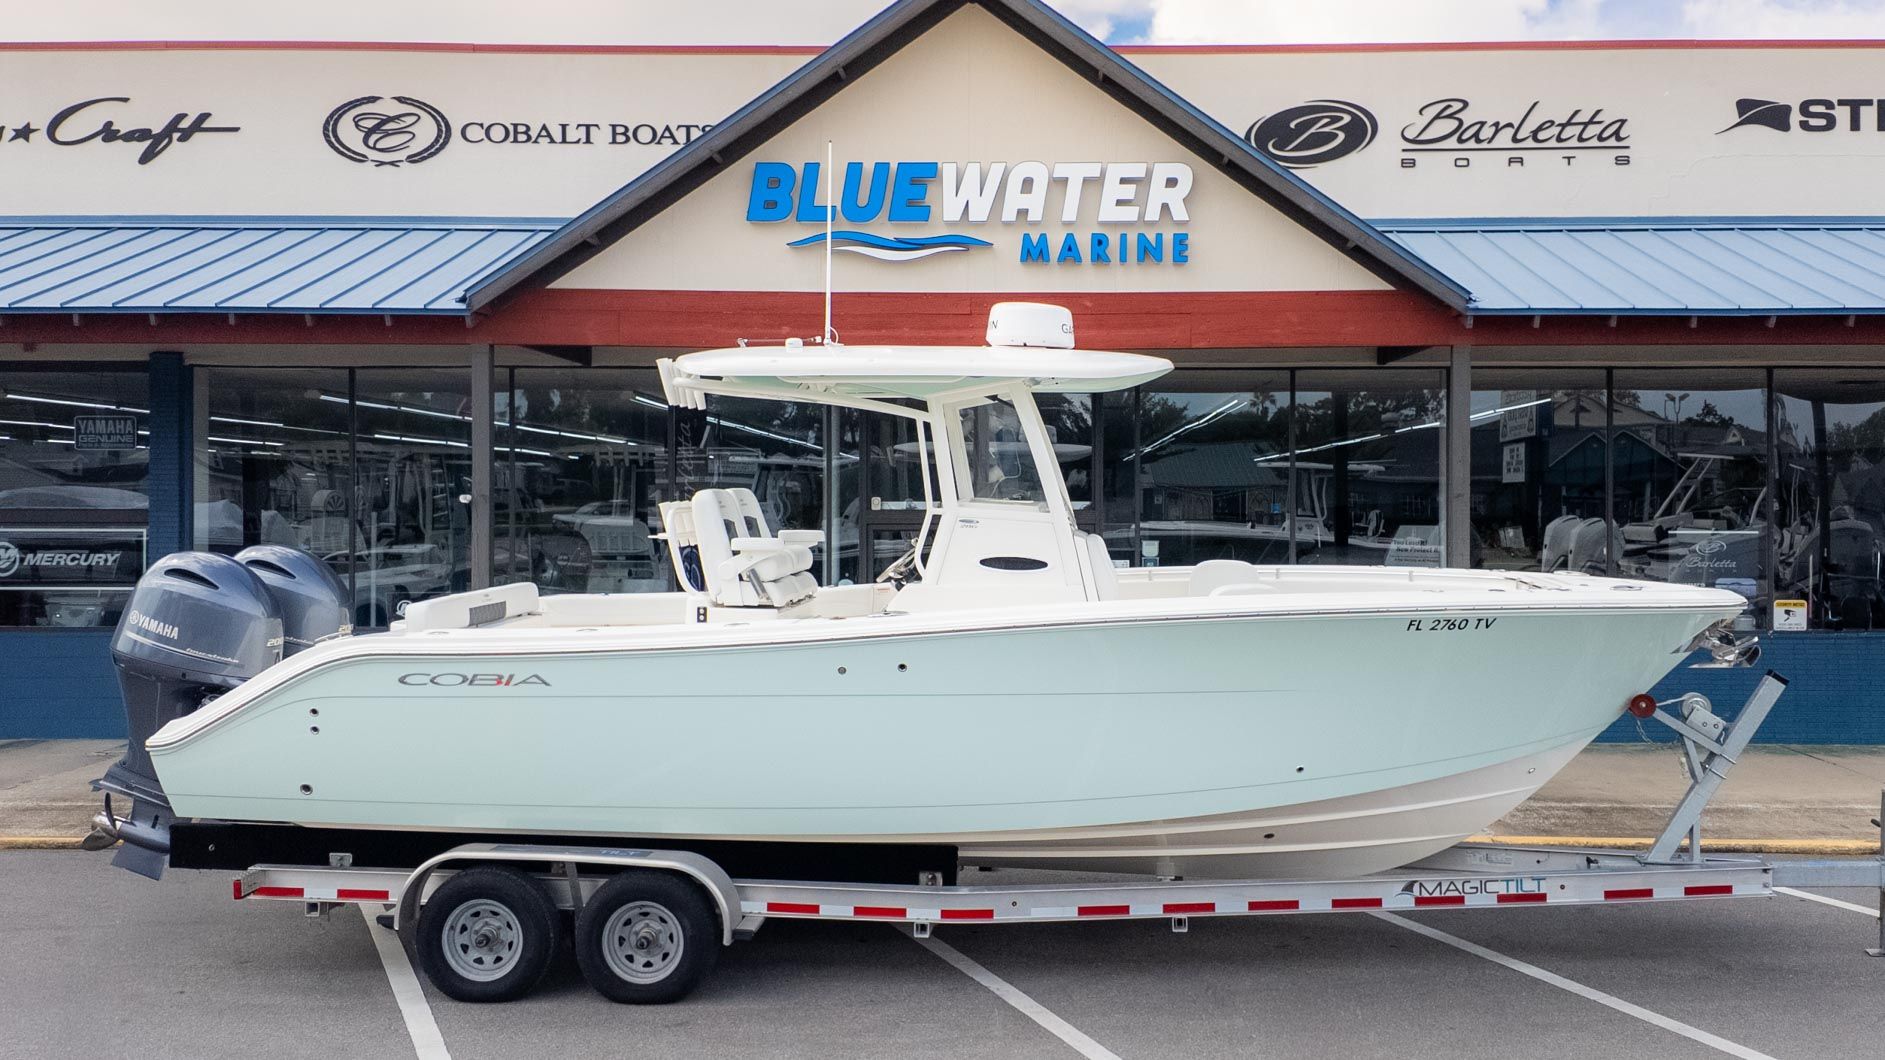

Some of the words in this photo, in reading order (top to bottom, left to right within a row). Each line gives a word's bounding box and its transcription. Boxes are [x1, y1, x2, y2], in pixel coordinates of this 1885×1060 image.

[1401, 98, 1631, 145] Barletta
[1798, 98, 1885, 132] ST
[46, 97, 240, 165] Craft
[460, 122, 600, 144] COBALT
[1401, 155, 1631, 168] BOATS
[1019, 232, 1189, 263] MARINE
[78, 419, 134, 434] YAMAHA
[79, 434, 134, 443] GENUINE
[23, 553, 121, 566] MERCURY
[1685, 557, 1737, 568] Barletta
[138, 614, 179, 640] YAMAHA
[1406, 618, 1423, 631] FL
[1429, 618, 1470, 631] 2760
[1475, 617, 1497, 630] TV
[397, 672, 553, 687] COBIA
[1418, 876, 1547, 896] MAGICTILT
